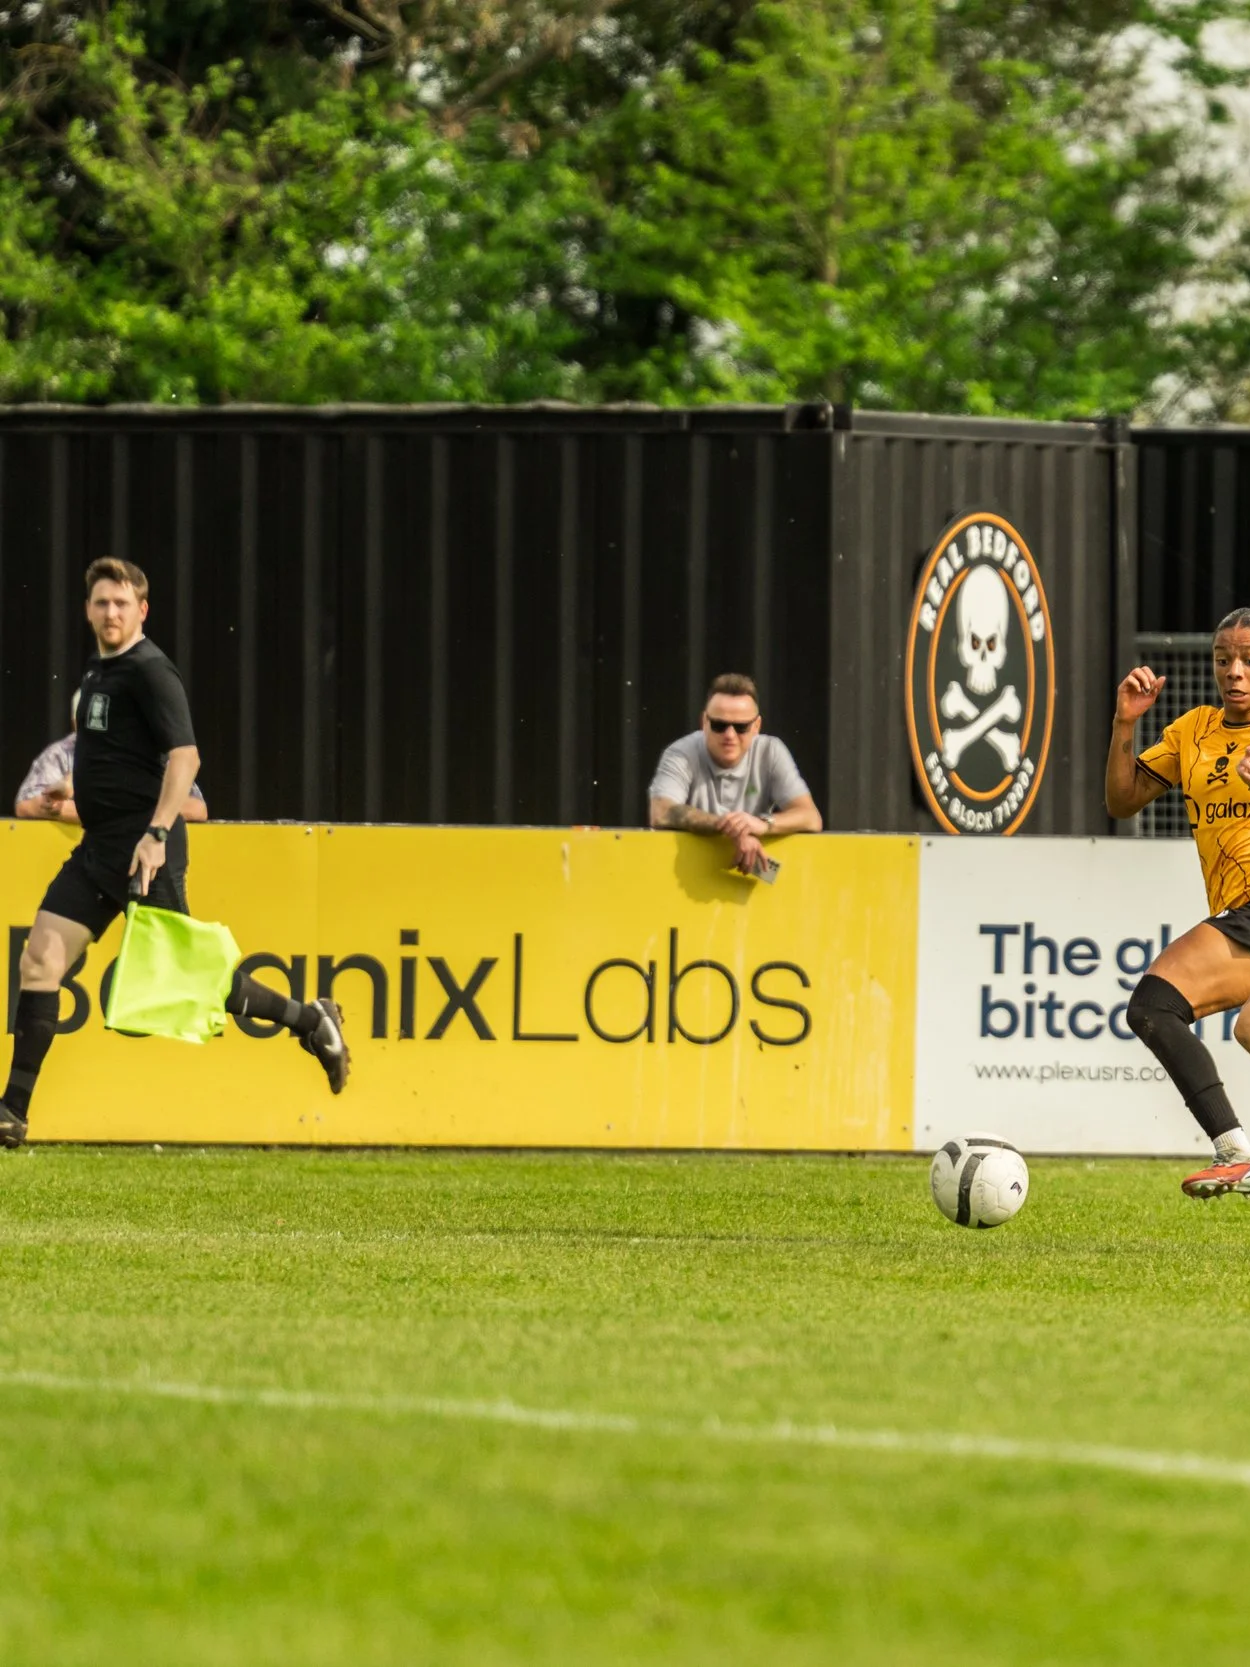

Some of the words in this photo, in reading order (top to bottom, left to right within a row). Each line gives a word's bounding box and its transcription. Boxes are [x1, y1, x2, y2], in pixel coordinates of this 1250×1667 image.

[918, 541, 965, 632] REAL
[965, 524, 1045, 642] BEDFORD
[925, 752, 949, 804] EST.
[948, 797, 994, 832] BLOCK
[979, 921, 1101, 976] The
[979, 982, 1204, 1041] bitco
[974, 1060, 1170, 1085] www.plexusrs.co
